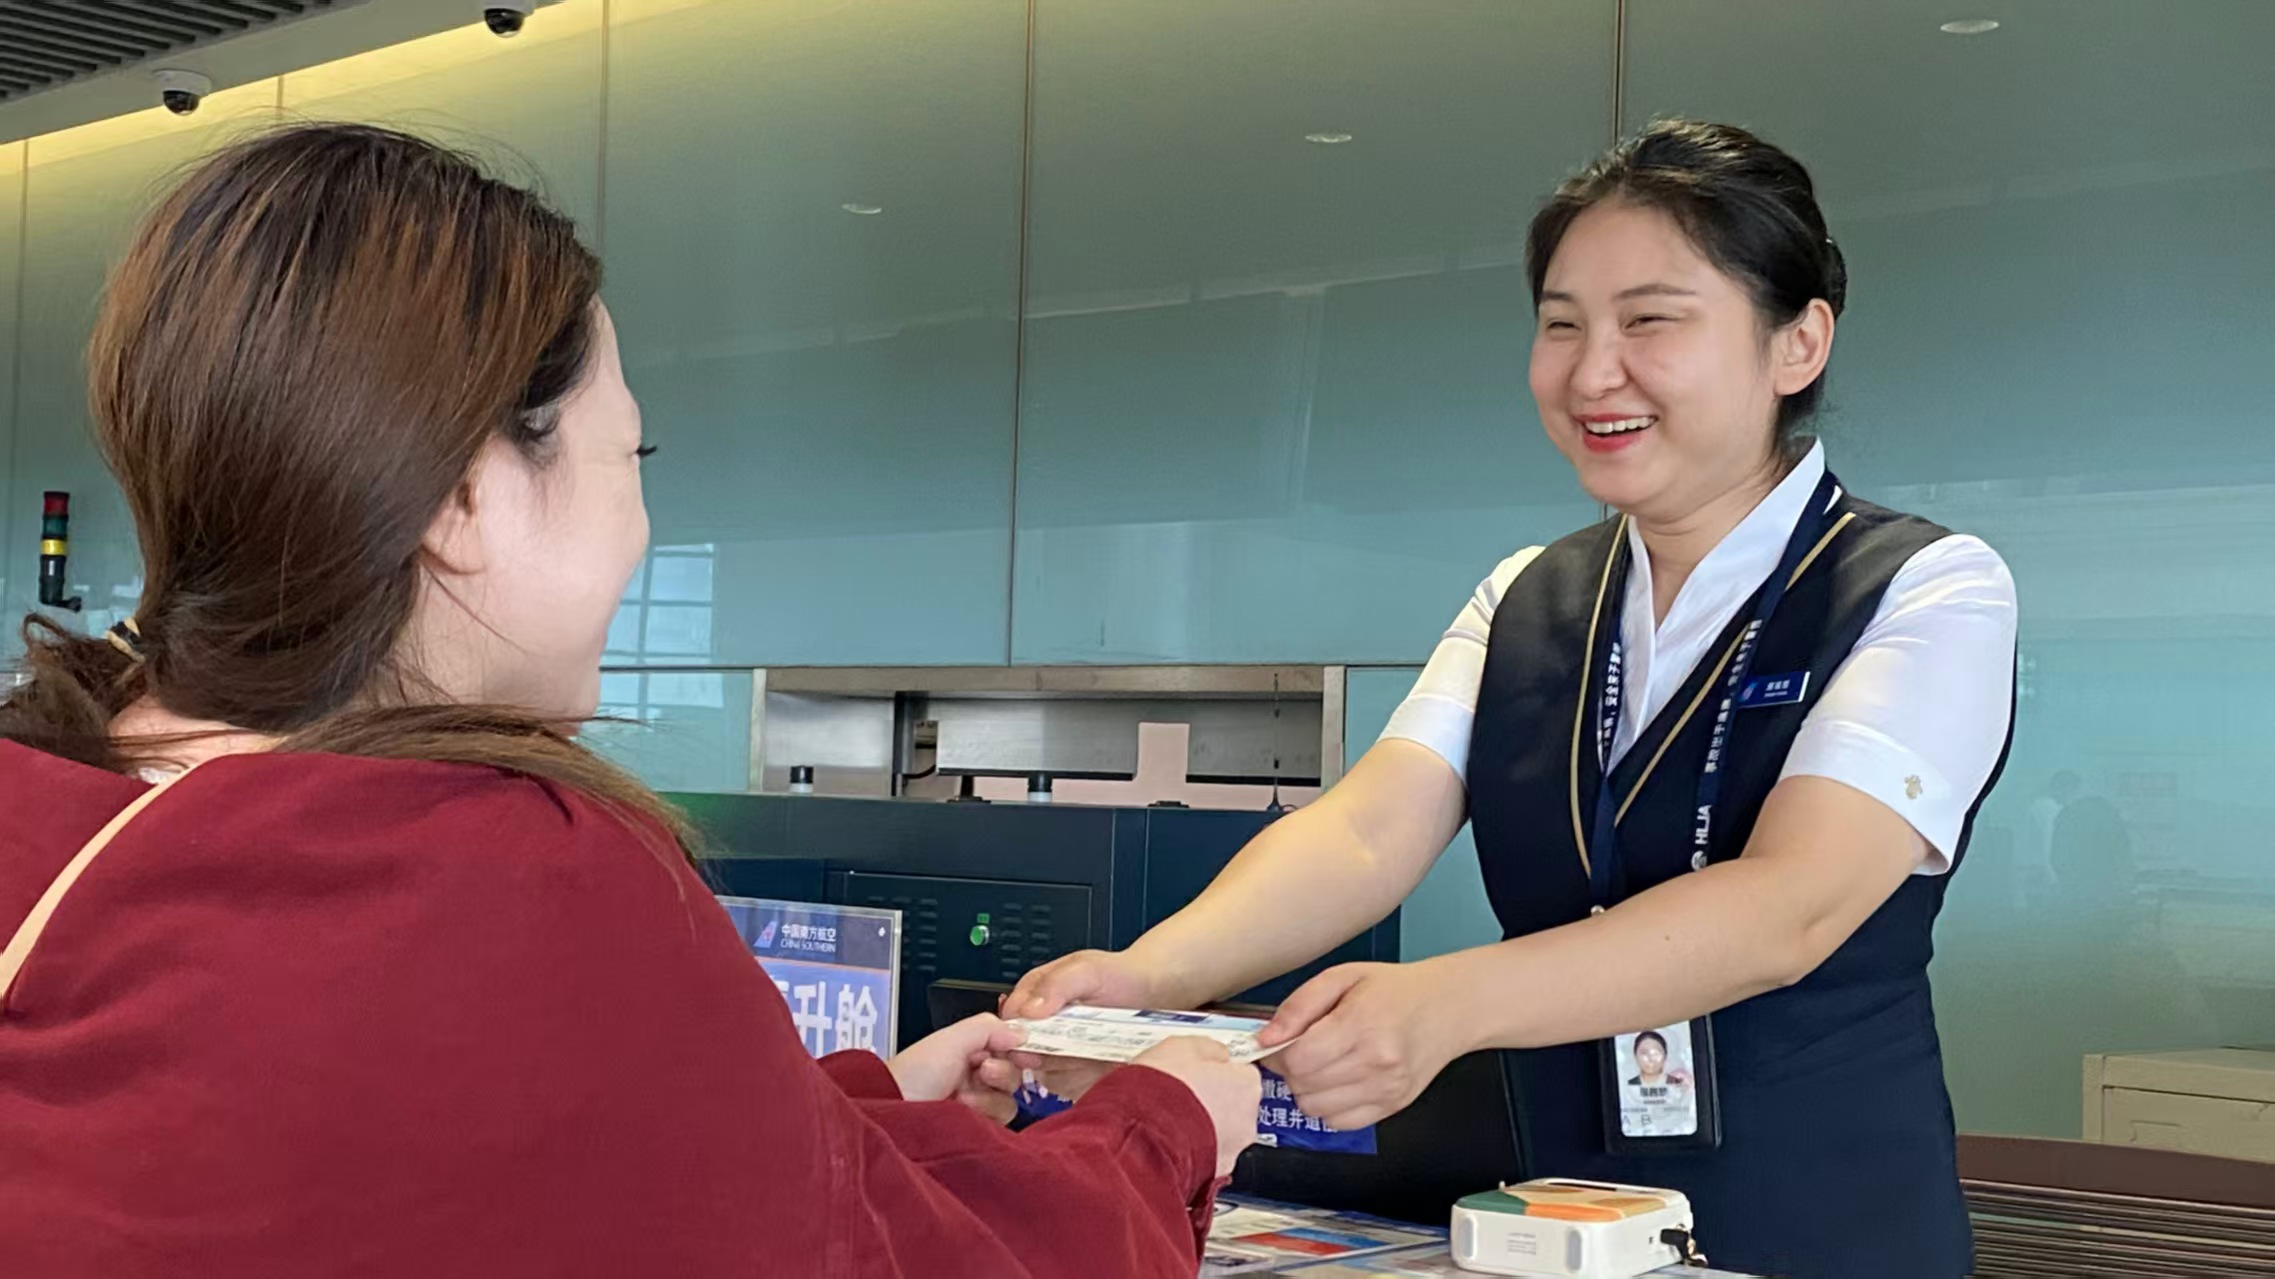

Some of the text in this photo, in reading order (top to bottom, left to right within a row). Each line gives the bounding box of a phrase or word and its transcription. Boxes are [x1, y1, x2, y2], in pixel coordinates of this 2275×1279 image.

[1695, 804, 1712, 845] HLJA
[781, 923, 836, 942] 中国南方航空
[770, 975, 878, 1059] 升舱
